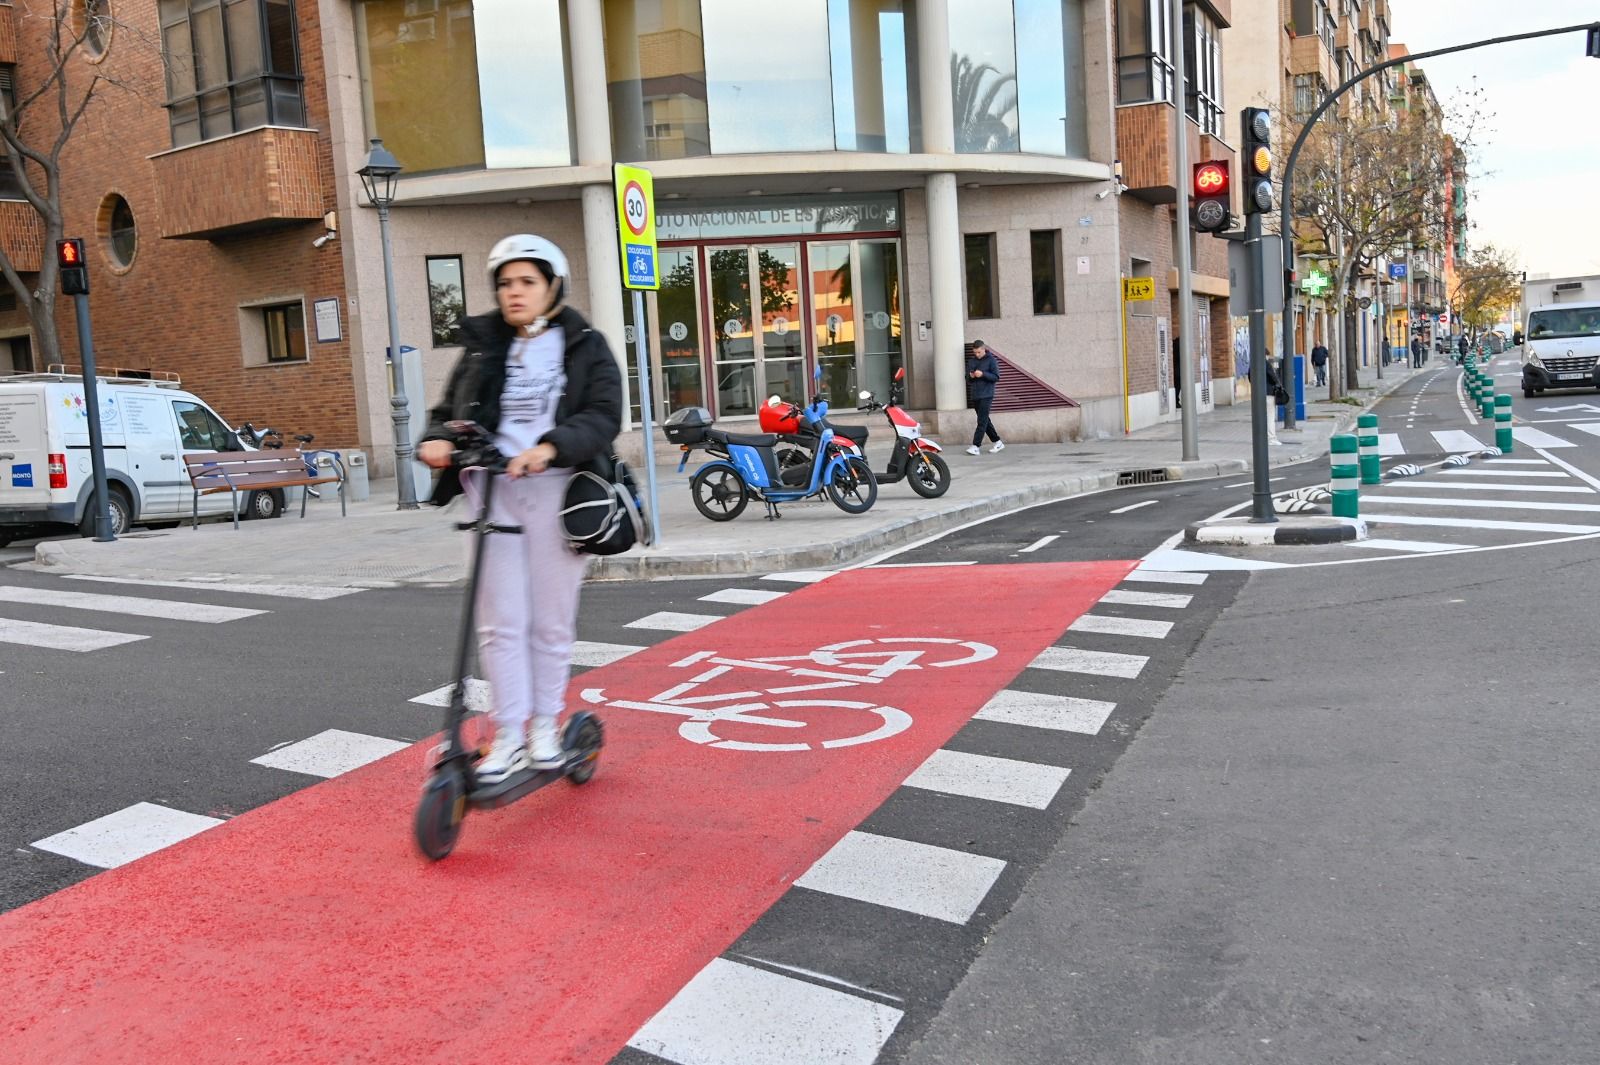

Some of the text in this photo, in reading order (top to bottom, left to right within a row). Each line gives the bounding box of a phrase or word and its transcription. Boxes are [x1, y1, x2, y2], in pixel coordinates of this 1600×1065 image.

[628, 199, 643, 217] 30
[689, 209, 767, 226] NACIONAL
[770, 208, 791, 223] DE
